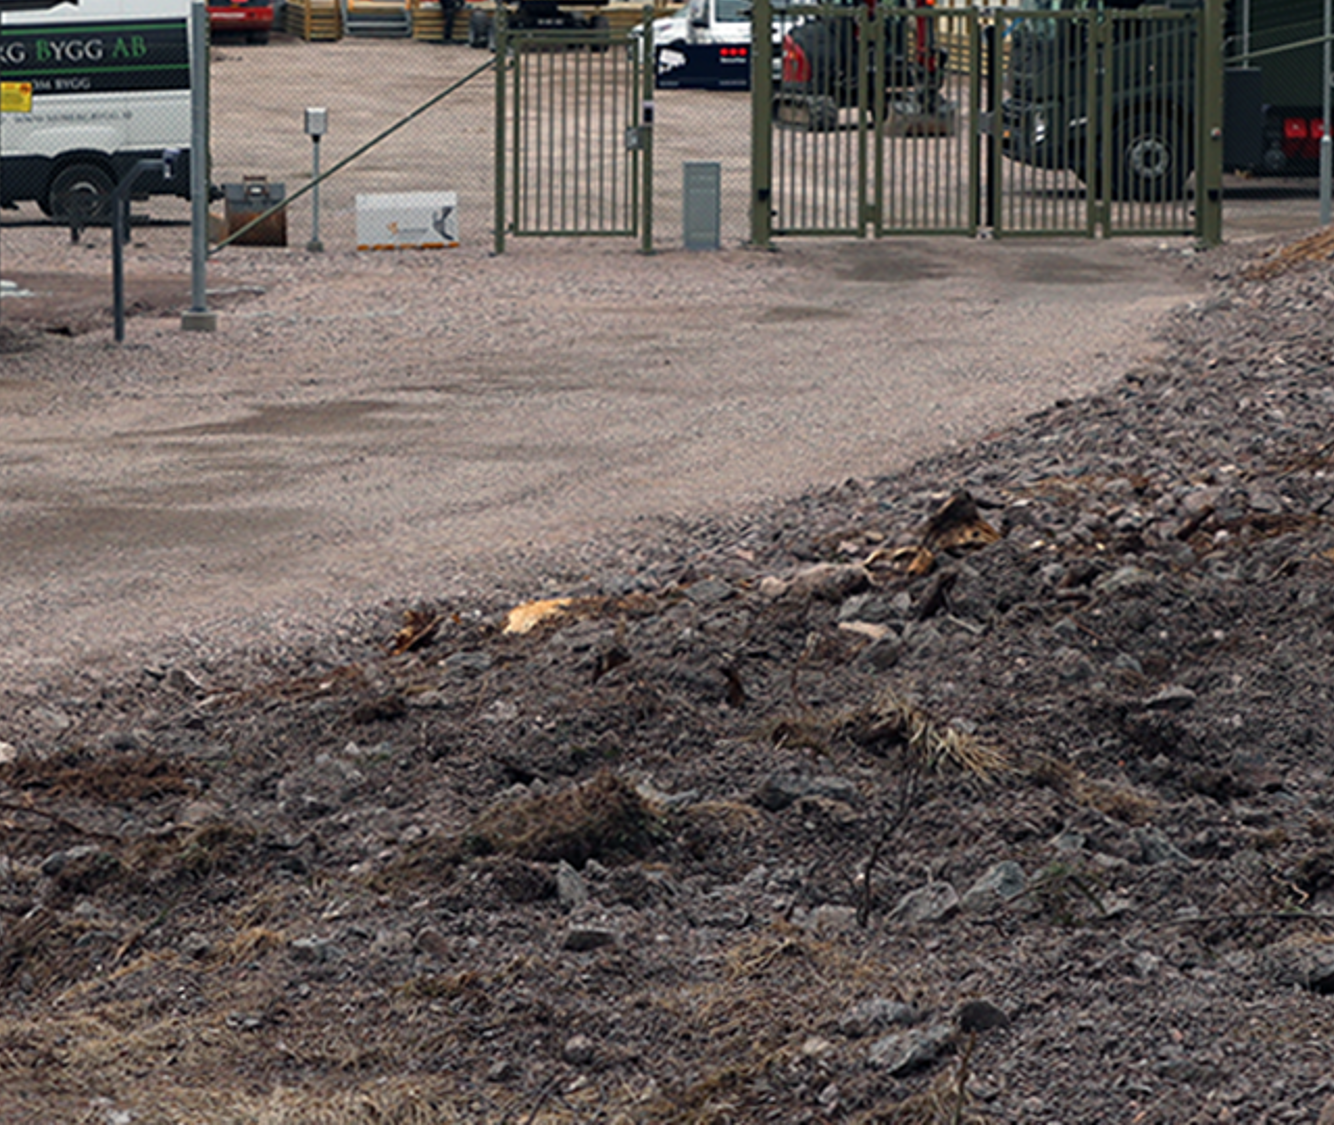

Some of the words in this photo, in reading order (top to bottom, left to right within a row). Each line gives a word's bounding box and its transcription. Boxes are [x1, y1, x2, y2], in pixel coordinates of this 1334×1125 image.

[36, 38, 104, 62] BYGG
[111, 35, 147, 58] AB
[54, 76, 91, 90] BYGG
